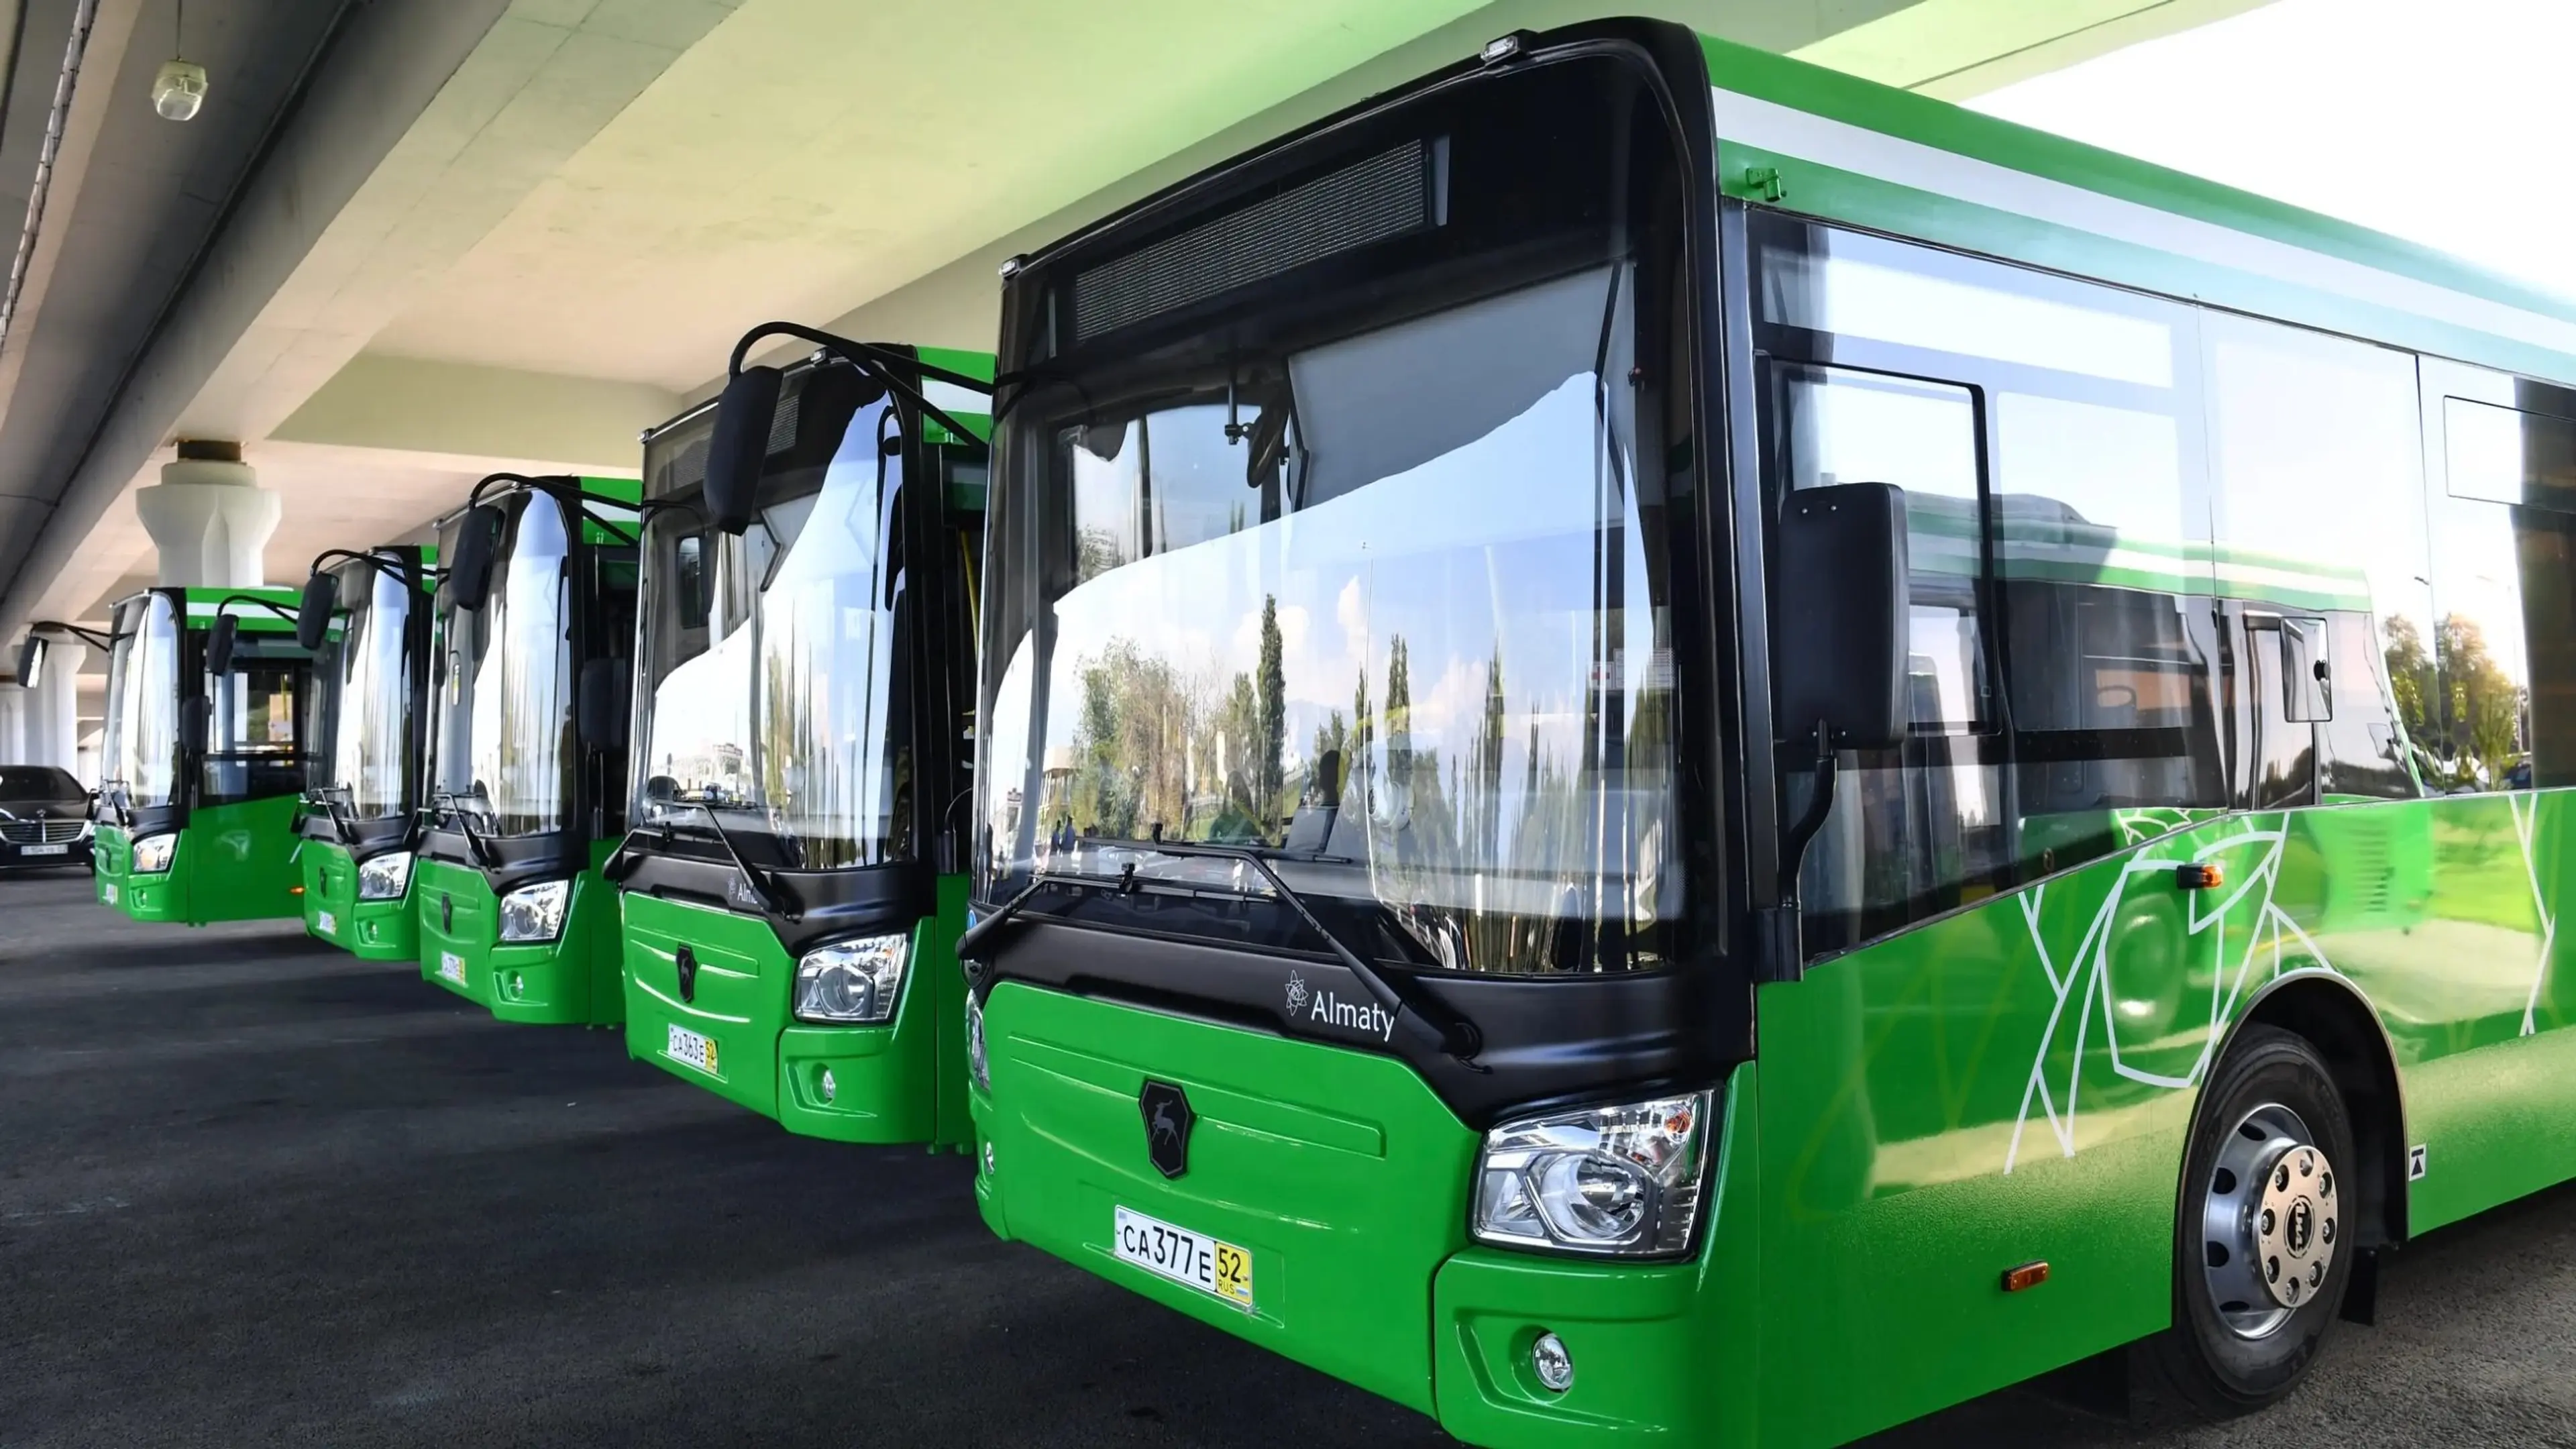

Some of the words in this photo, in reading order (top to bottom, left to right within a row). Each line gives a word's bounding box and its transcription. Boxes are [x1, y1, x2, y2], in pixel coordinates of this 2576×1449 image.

[1311, 990, 1395, 1042] Almaty
[1124, 1225, 1211, 1283] CA377E
[1218, 1248, 1241, 1283] 52
[1218, 1279, 1235, 1295] RUS
